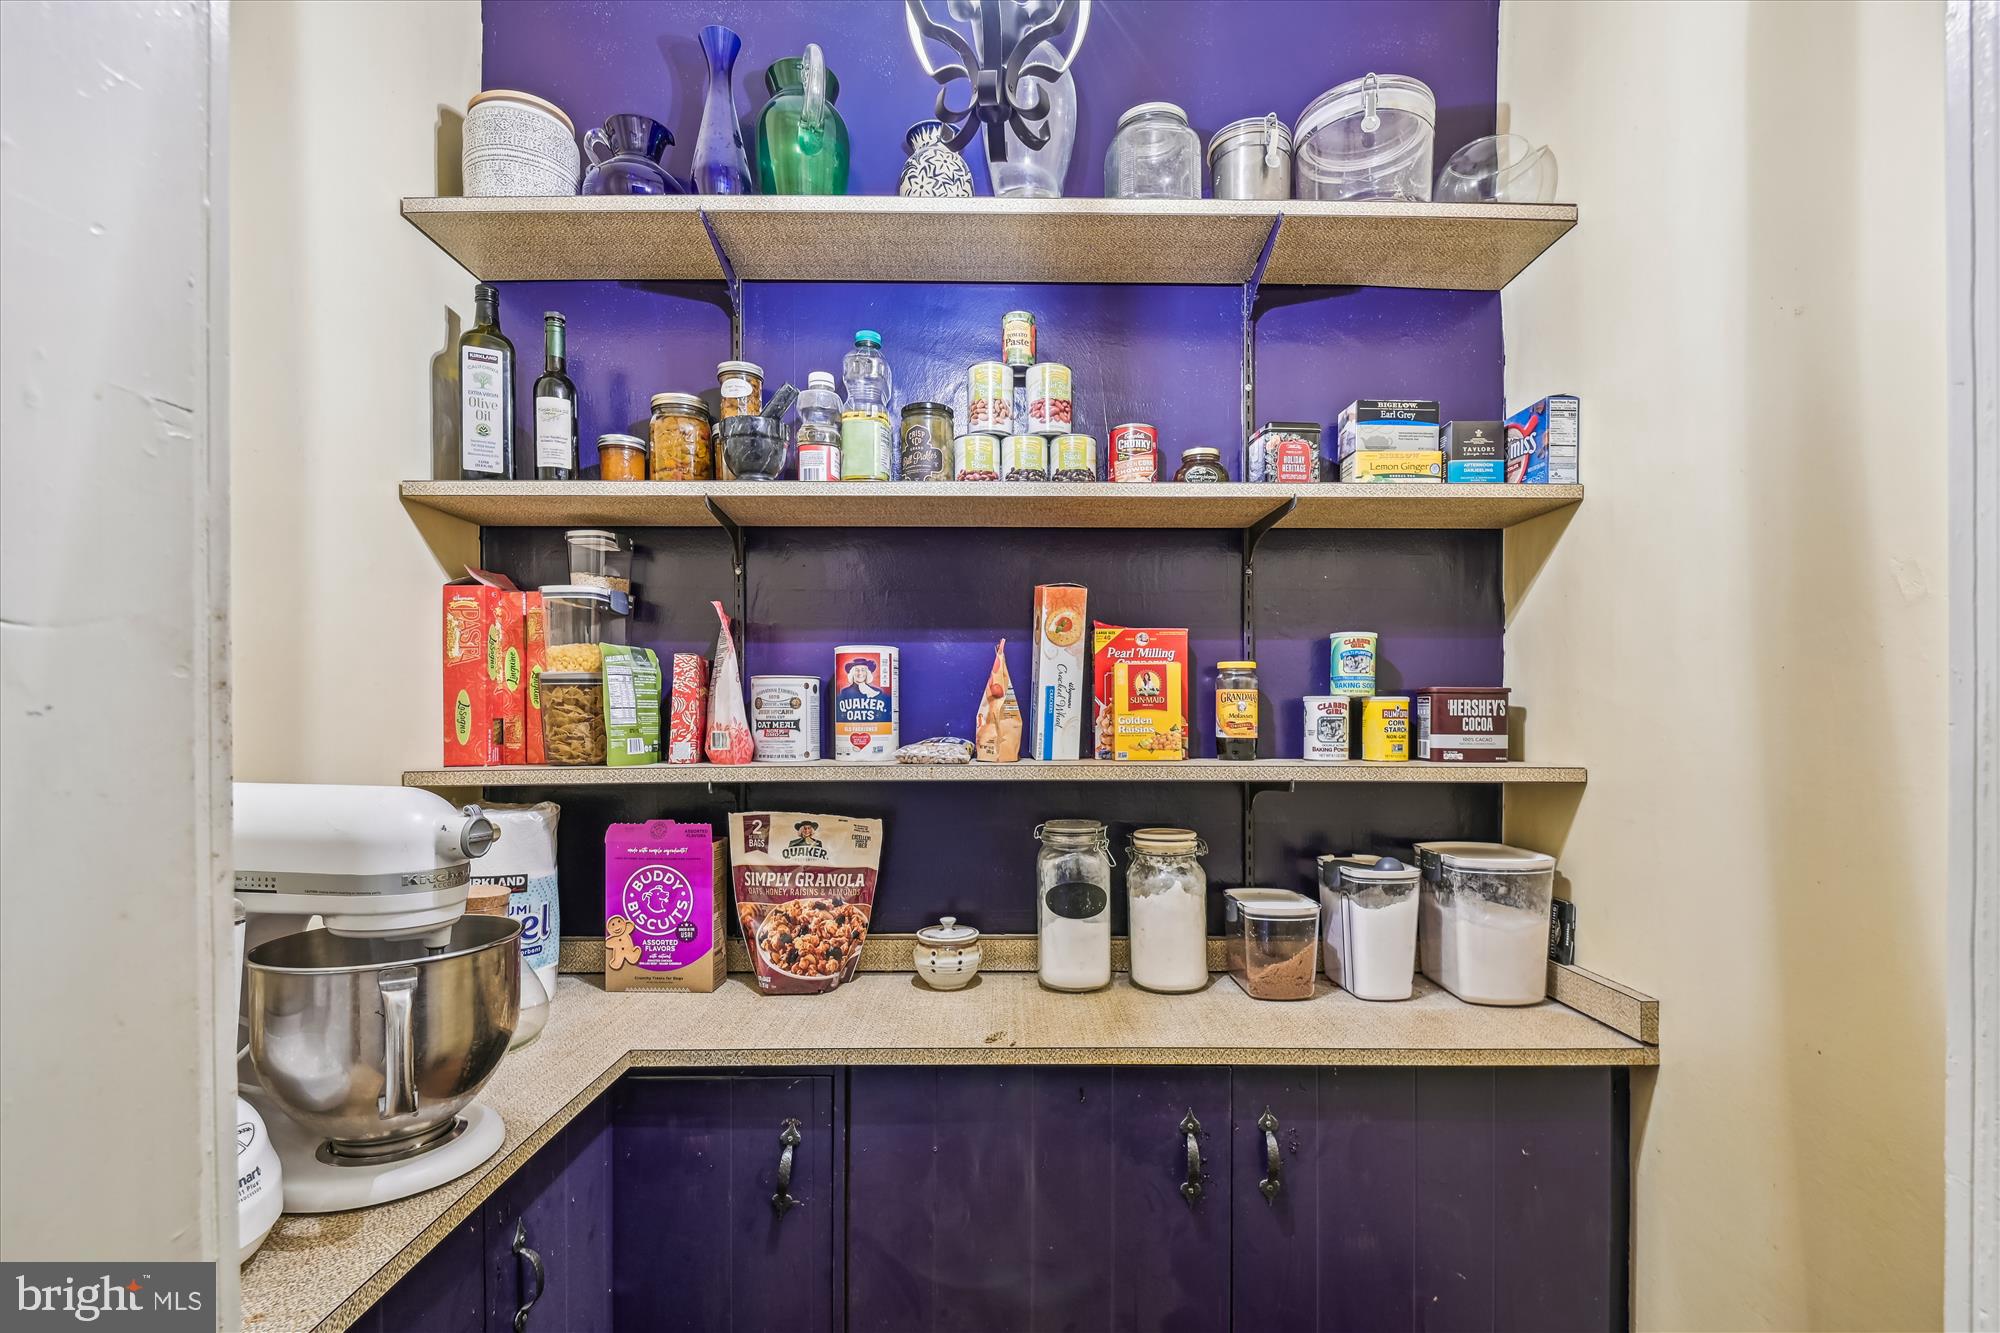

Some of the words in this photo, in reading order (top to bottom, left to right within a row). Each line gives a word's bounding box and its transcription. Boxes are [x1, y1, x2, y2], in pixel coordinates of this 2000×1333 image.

[1005, 338, 1029, 347] Paste
[469, 352, 498, 361] KIRKLAND
[467, 365, 498, 374] CALIFORNIA
[468, 396, 498, 410] Olive
[475, 410, 491, 422] Oil
[1380, 410, 1396, 418] Earl
[1397, 410, 1416, 420] Grey
[909, 430, 926, 440] CRISP
[1118, 440, 1151, 450] CHUNKY
[1282, 464, 1306, 472] HERITAGE
[1370, 462, 1398, 470] Lemon
[1400, 462, 1430, 473] Ginger
[1107, 647, 1134, 658] Pearl
[1136, 648, 1175, 661] Milling
[507, 652, 518, 685] Linguine
[1056, 664, 1068, 700] Cracked
[840, 698, 886, 712] QUAKER
[1449, 699, 1506, 716] HERSHEY'S
[847, 710, 874, 720] OATS
[1055, 700, 1066, 728] Wheat
[1118, 716, 1152, 725] Golden
[1462, 717, 1494, 731] COCOA
[752, 820, 762, 835] 2
[749, 839, 765, 848] BAGS
[782, 847, 828, 860] QUAKER
[470, 876, 526, 887] IRKLAND
[631, 870, 684, 892] BUDDY
[744, 872, 793, 887] SIMPLY
[795, 872, 865, 887] GRANOLA
[765, 888, 789, 896] HONEY,
[627, 900, 688, 930] BISCUITS
